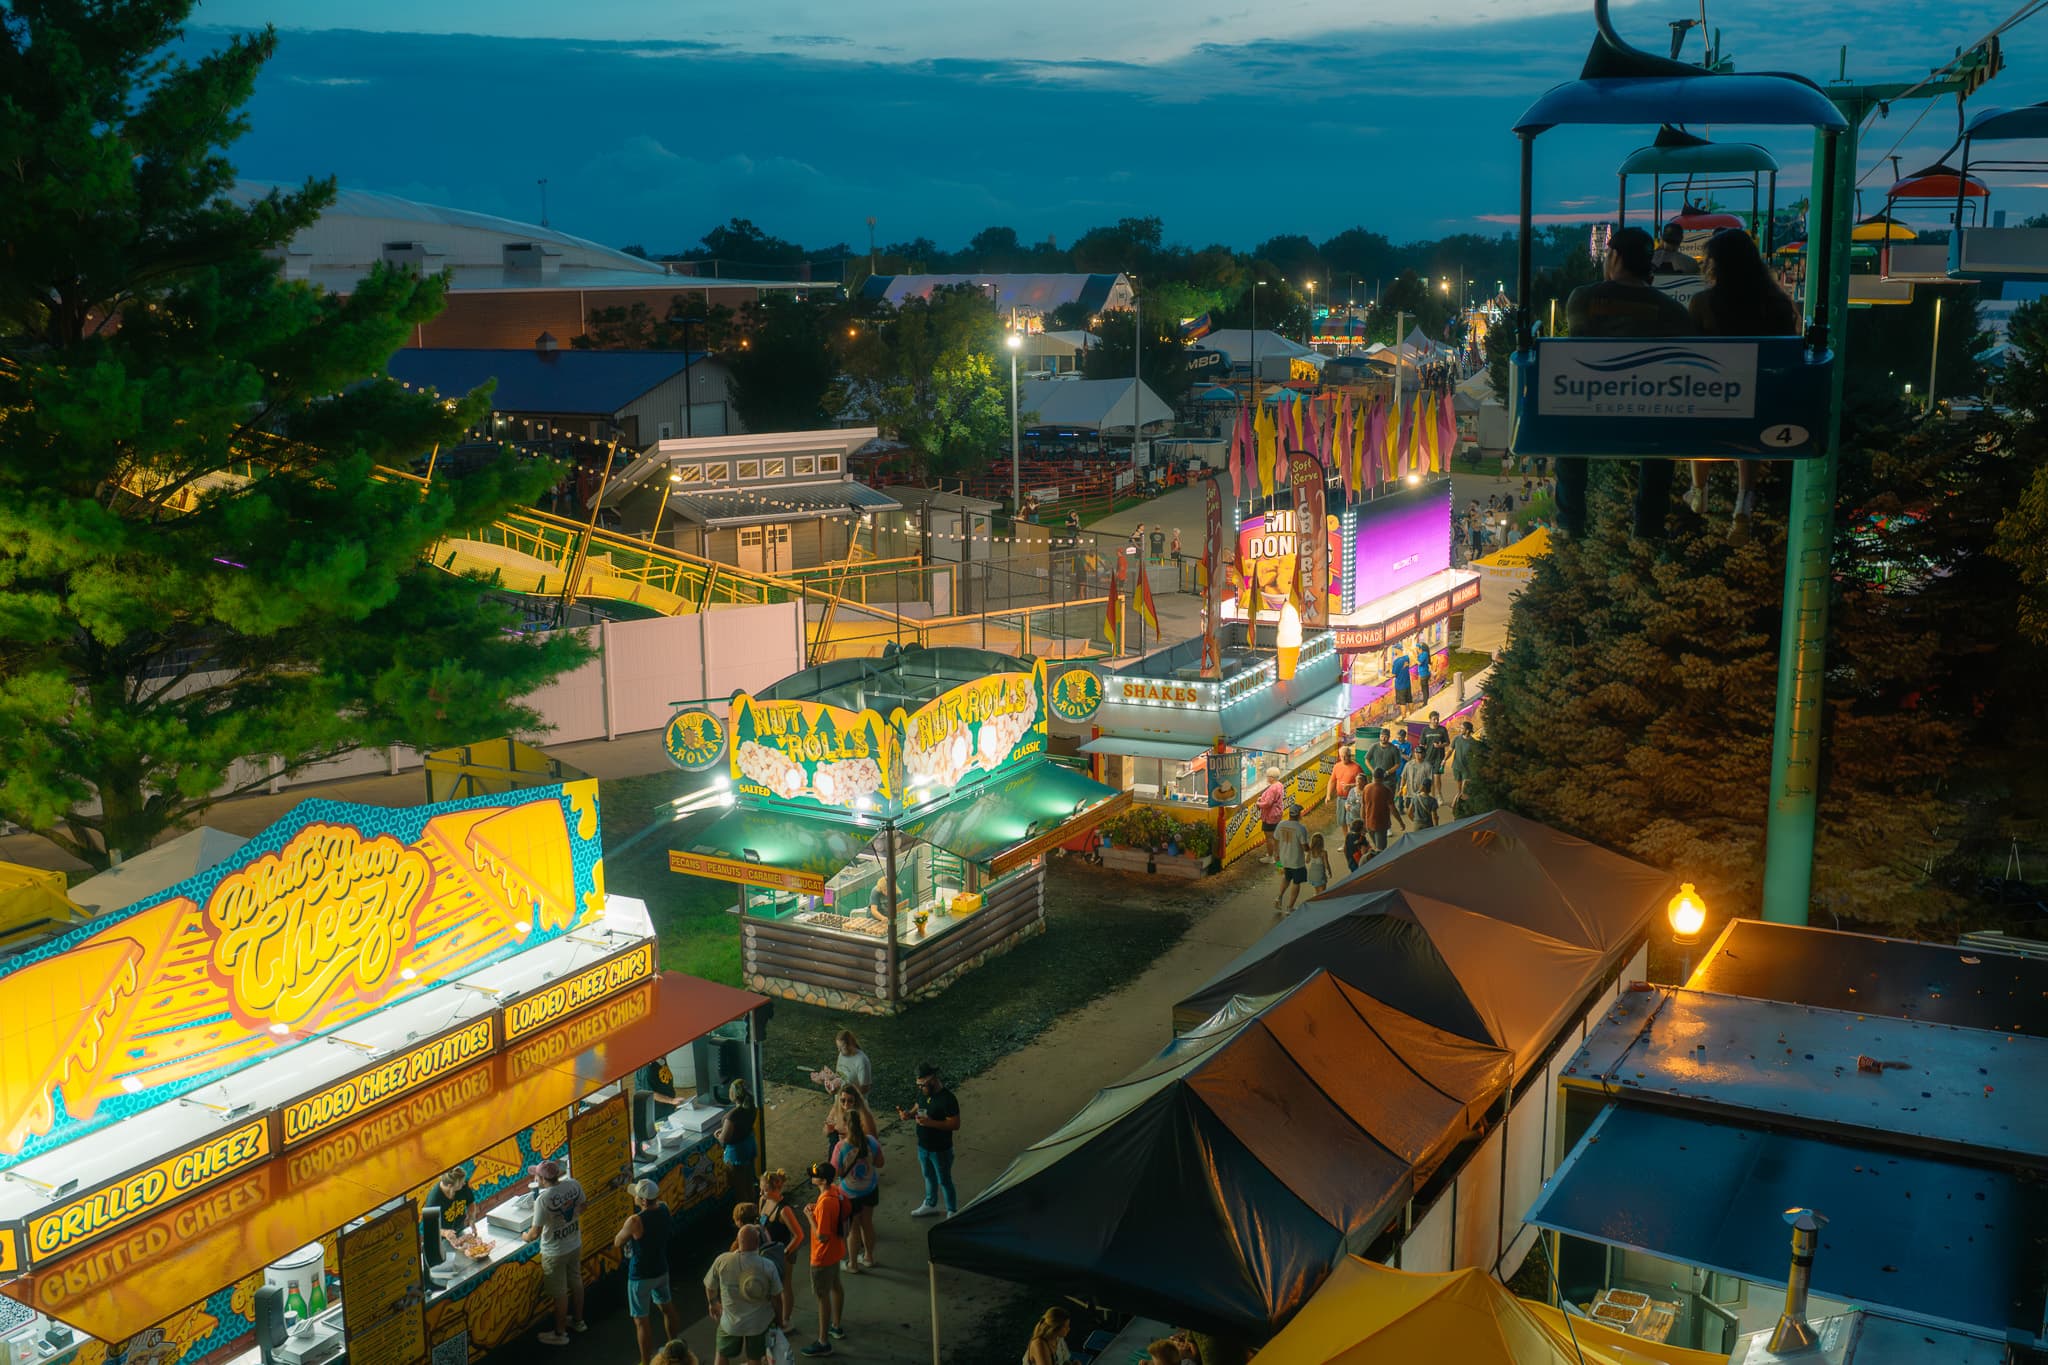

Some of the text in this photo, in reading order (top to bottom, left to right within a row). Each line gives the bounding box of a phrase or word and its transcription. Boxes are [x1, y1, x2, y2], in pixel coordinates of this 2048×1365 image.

[1553, 374, 1741, 402] SuperiorSleep
[1595, 403, 1697, 414] EXPERIENCE
[1775, 427, 1793, 444] 4
[1292, 458, 1313, 474] Soft
[1293, 472, 1319, 486] Serve
[1264, 511, 1297, 533] MI
[1300, 540, 1318, 622] CREAM
[1461, 582, 1477, 601] DONUTS
[1434, 598, 1448, 616] CAKES
[1386, 613, 1416, 637] MINI DONUTS
[1335, 630, 1382, 645] LEMONADE
[1123, 684, 1197, 702] SHAKES
[1229, 671, 1265, 698] SUNDAES
[917, 679, 1027, 753] NUT ROLLS
[1059, 699, 1096, 716] ROLLS
[752, 704, 802, 736] NUT
[676, 743, 719, 764] ROLLS
[787, 729, 869, 762] ROLLS
[1013, 740, 1041, 761] CLASSIC
[1209, 755, 1240, 770] DONUT
[739, 784, 771, 797] SALTED
[217, 834, 400, 931] What's Your
[671, 856, 824, 891] PECANS PEANUTS CARAMEL NOUGAT
[221, 858, 425, 1026] Cheez?
[512, 949, 647, 1033] LOADED CHEEZ CHIPS
[287, 1021, 490, 1138] LOADED CHEEZ POTATOES
[36, 1124, 262, 1252] GRILLED CHEEZ
